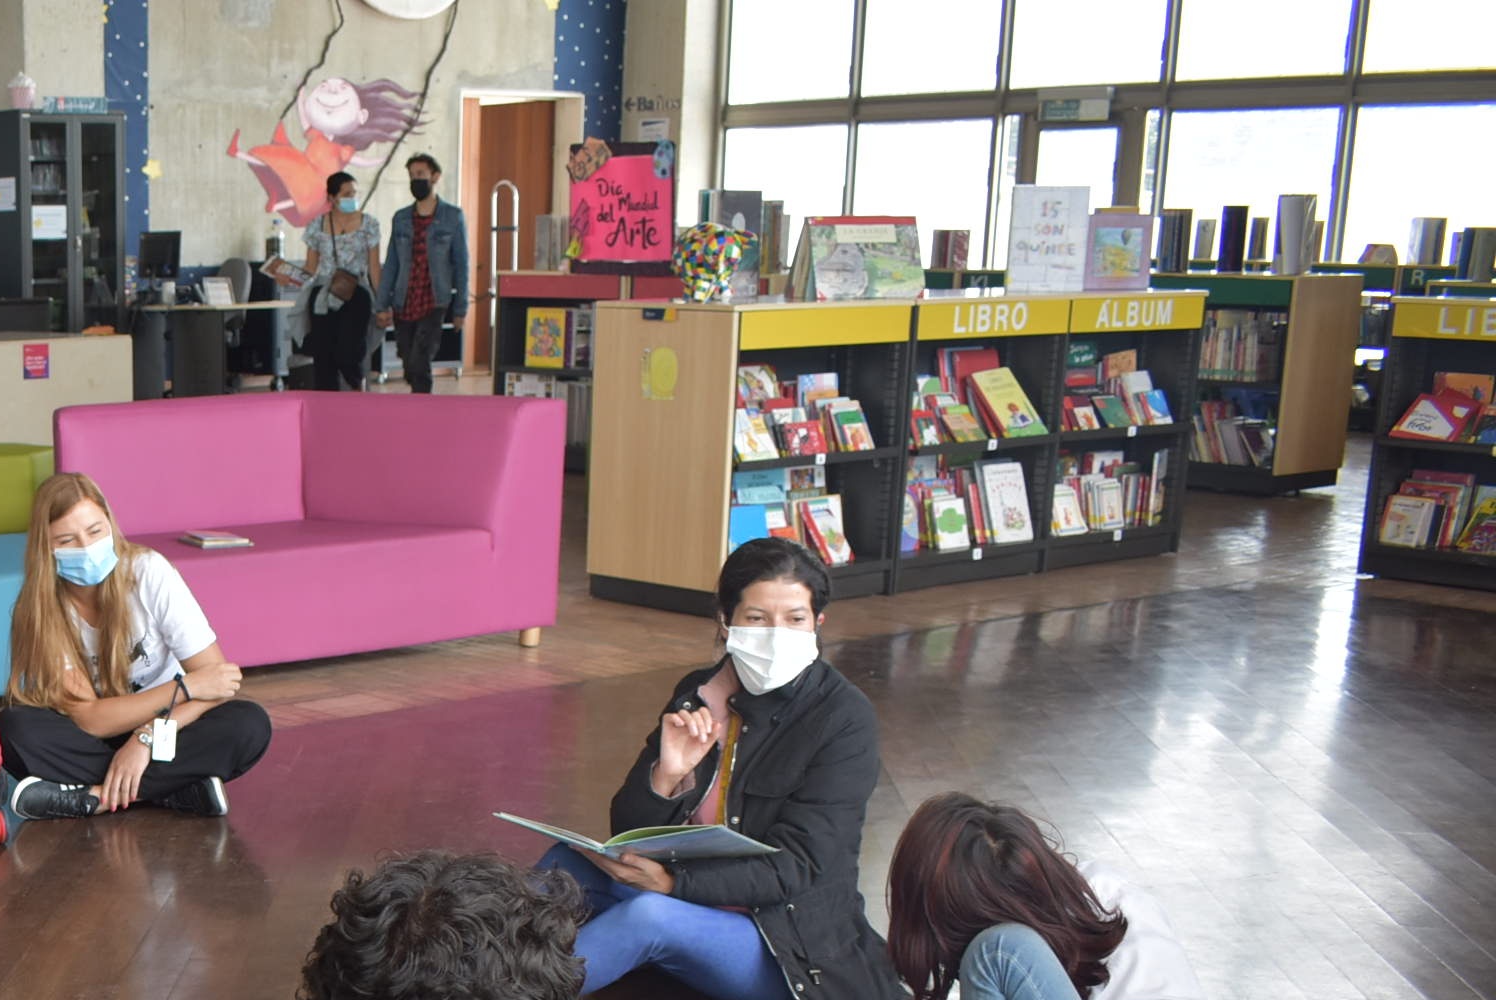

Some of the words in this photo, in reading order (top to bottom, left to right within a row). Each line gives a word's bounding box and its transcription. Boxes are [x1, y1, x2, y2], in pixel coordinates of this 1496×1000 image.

[637, 96, 680, 112] Baños
[596, 178, 623, 197] Día
[618, 191, 659, 212] Mundial
[1040, 201, 1063, 218] 15
[597, 204, 615, 223] del
[605, 217, 662, 250] Arte
[1033, 222, 1065, 237] SON
[953, 302, 1029, 333] LIBRO
[1095, 299, 1175, 328] ÁLBUM
